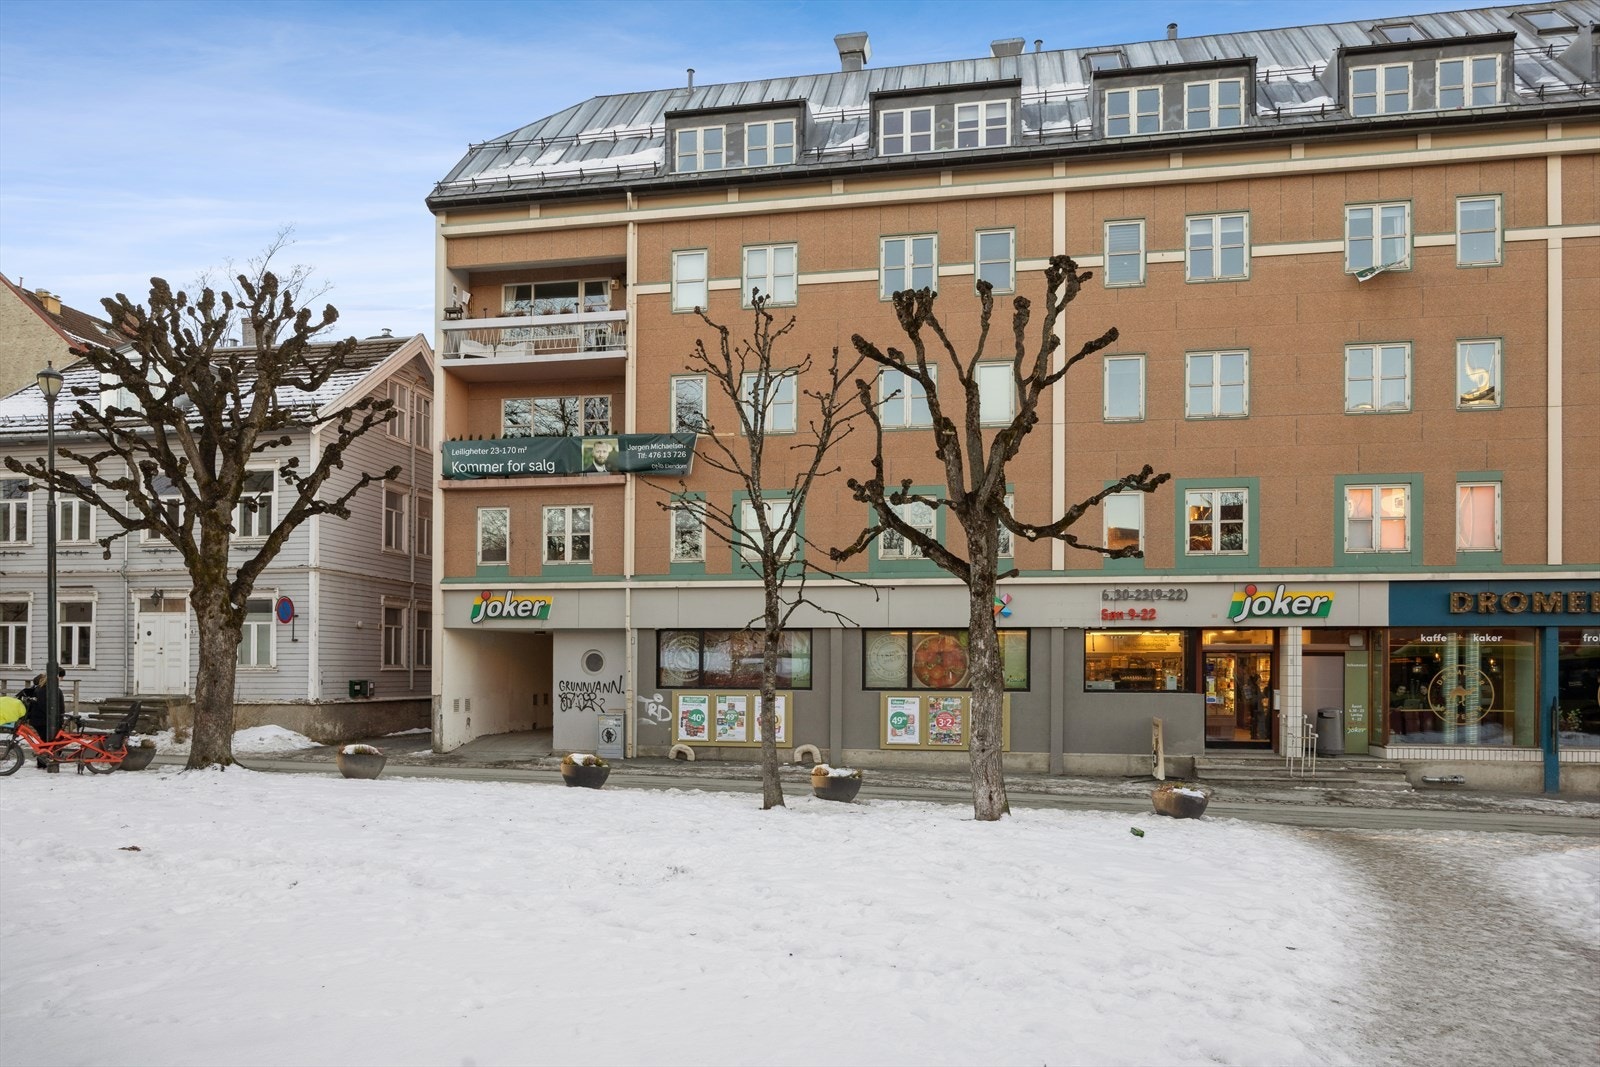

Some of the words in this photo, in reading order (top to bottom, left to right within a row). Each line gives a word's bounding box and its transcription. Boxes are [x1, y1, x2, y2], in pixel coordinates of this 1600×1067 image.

[451, 448, 489, 457] Leiligheter
[490, 446, 517, 455] 23-170
[627, 444, 650, 452] Jørgen
[451, 461, 505, 474] Kommer
[507, 460, 526, 472] for
[528, 458, 555, 474] salg
[472, 590, 546, 624] joker
[1233, 584, 1329, 623] joker
[1128, 608, 1157, 621] 9-22
[1420, 633, 1447, 642] kaffe
[1473, 633, 1503, 642] kaker
[1583, 633, 1600, 642] fro
